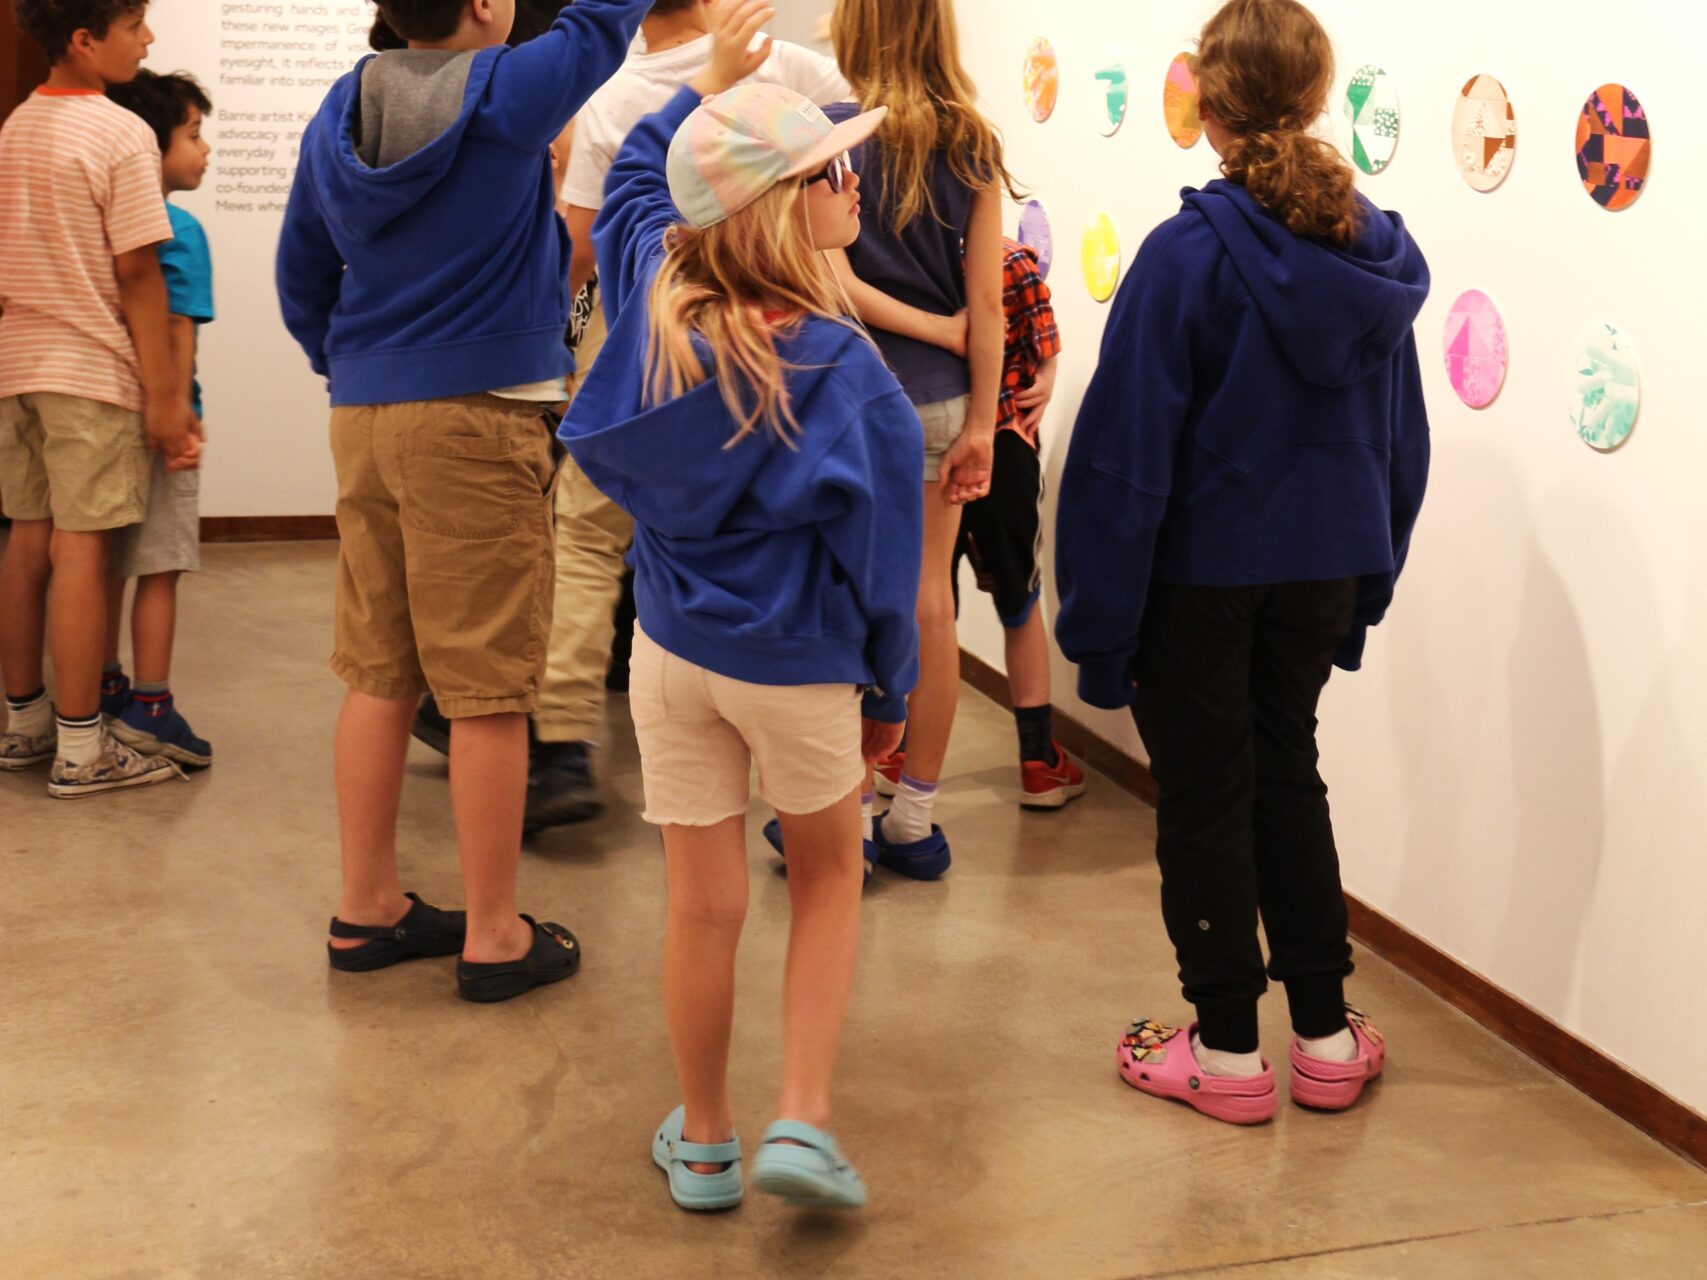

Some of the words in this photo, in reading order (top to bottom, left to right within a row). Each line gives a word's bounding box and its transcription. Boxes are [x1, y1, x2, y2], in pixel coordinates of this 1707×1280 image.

[222, 3, 283, 17] gesturing
[291, 3, 328, 16] hands
[336, 4, 360, 16] and
[221, 21, 258, 32] these
[263, 23, 289, 32] new
[220, 38, 316, 53] impermanence
[324, 39, 338, 52] of
[295, 56, 345, 70] reflects
[219, 73, 265, 86] familiar
[270, 75, 294, 87] into
[218, 109, 256, 122] Barrie
[259, 111, 293, 122] artist
[217, 127, 280, 143] advocacy
[216, 146, 276, 161] everyday
[216, 164, 287, 179] supporting
[215, 200, 253, 212] Mews
